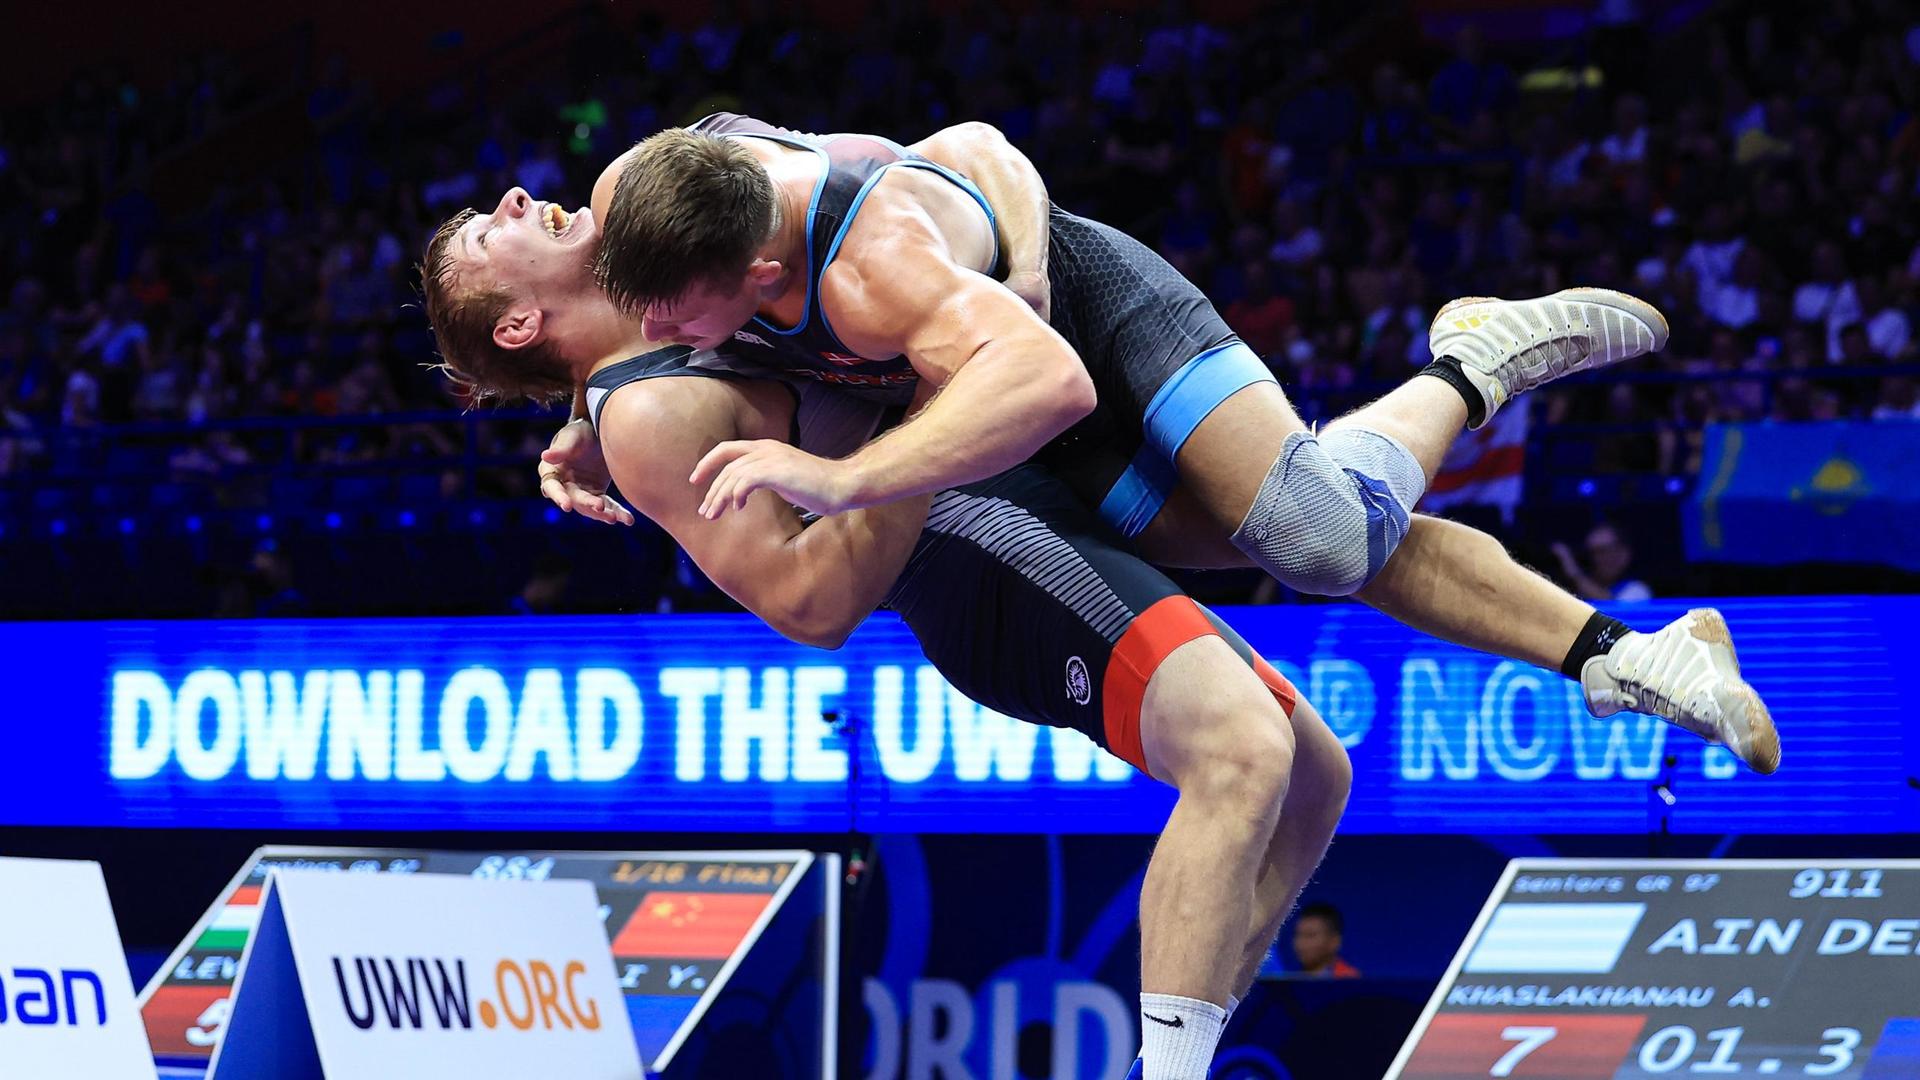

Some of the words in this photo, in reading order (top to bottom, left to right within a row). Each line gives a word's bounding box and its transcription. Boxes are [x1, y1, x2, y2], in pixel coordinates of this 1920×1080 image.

[109, 666, 644, 782] DOWNLOAD
[658, 667, 848, 782] THE
[696, 863, 790, 885] Final
[1512, 874, 1625, 894] Seniors
[1789, 868, 1884, 899] 911
[1646, 918, 1804, 955] AIN
[1817, 918, 1920, 956] DE
[0, 967, 108, 1026] an
[332, 955, 601, 1031] UWW.ORG
[1447, 985, 1714, 1008] KHASLAKHANAU
[1727, 986, 1771, 1008] A.
[860, 976, 1136, 1080] ORLD
[1489, 1025, 1558, 1078] 7
